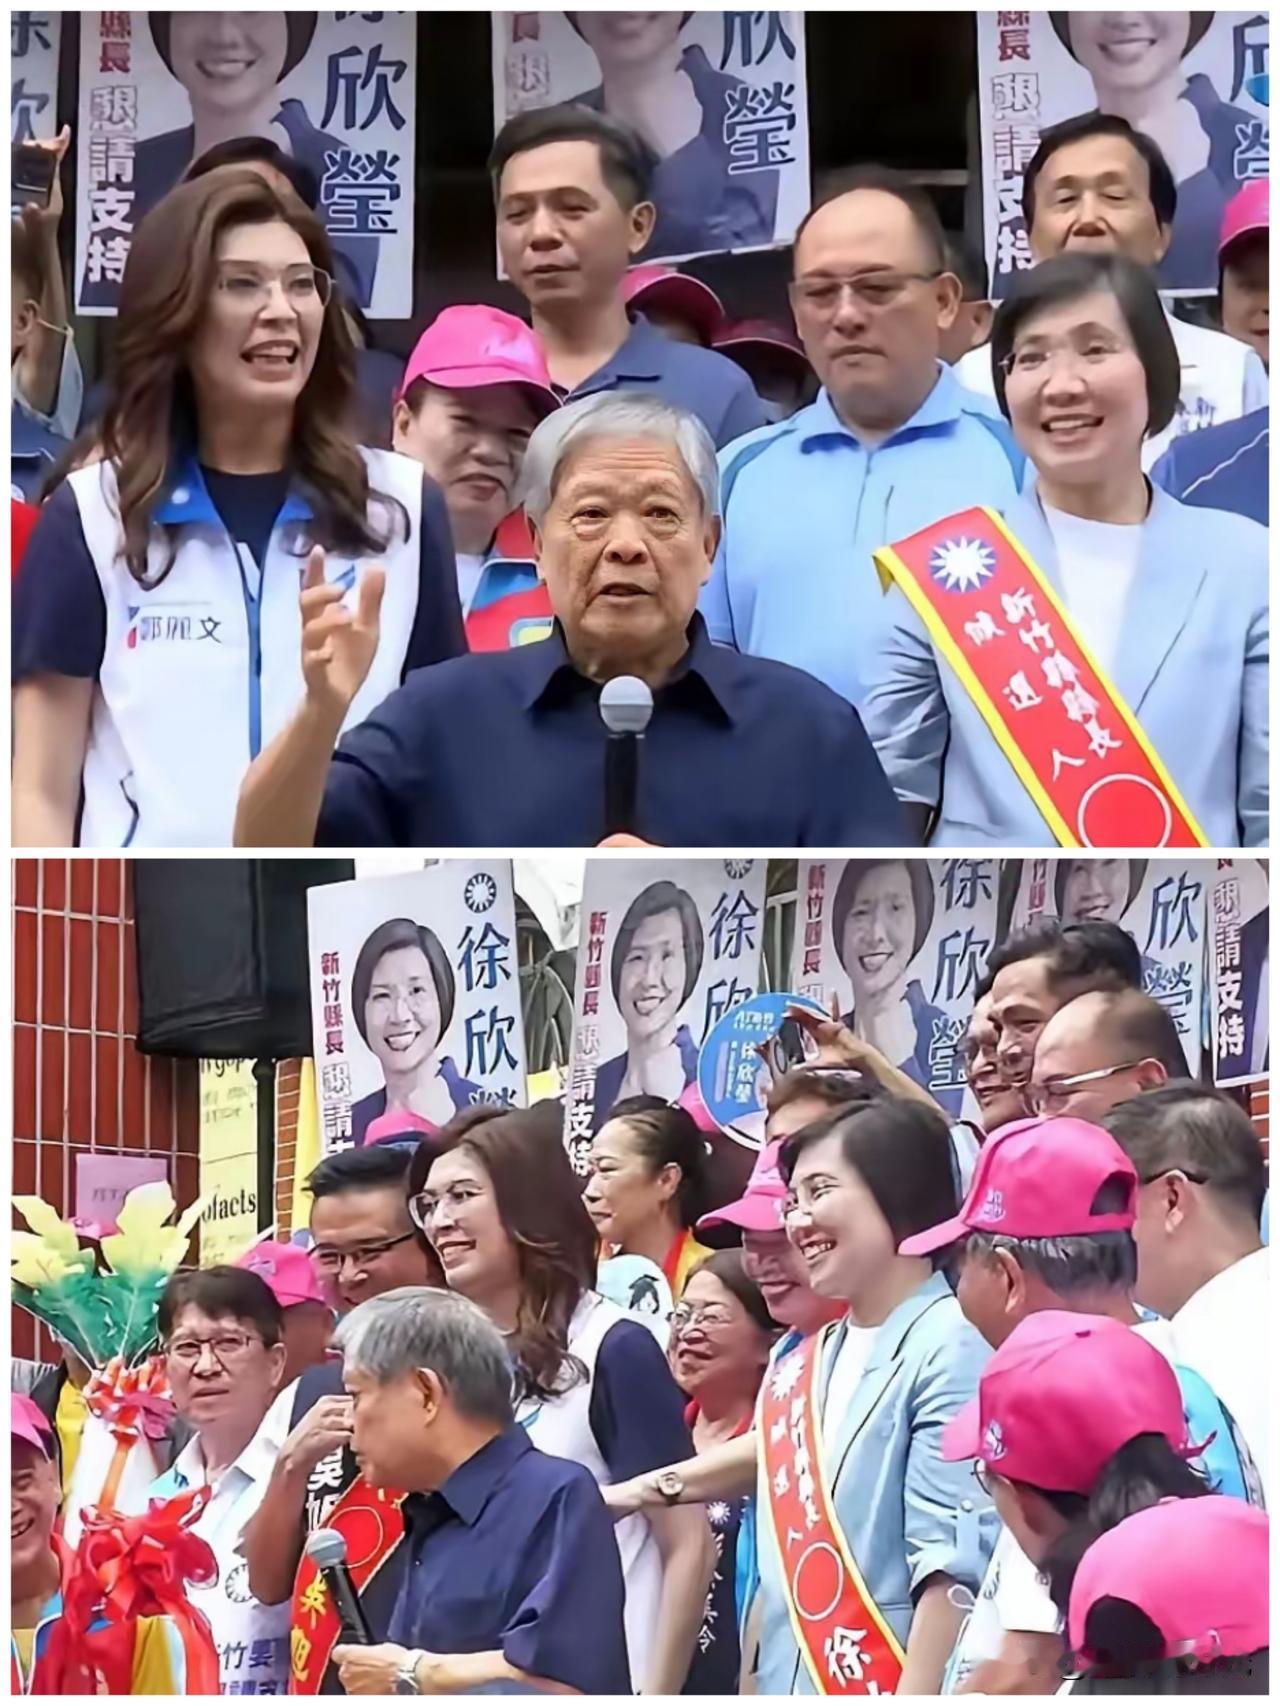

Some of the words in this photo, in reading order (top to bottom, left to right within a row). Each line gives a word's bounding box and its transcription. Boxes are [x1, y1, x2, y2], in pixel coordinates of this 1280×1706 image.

[319, 11, 411, 236] 欣瑩
[321, 952, 345, 1055] 新竹縣長
[456, 922, 518, 1107] 徐欣
